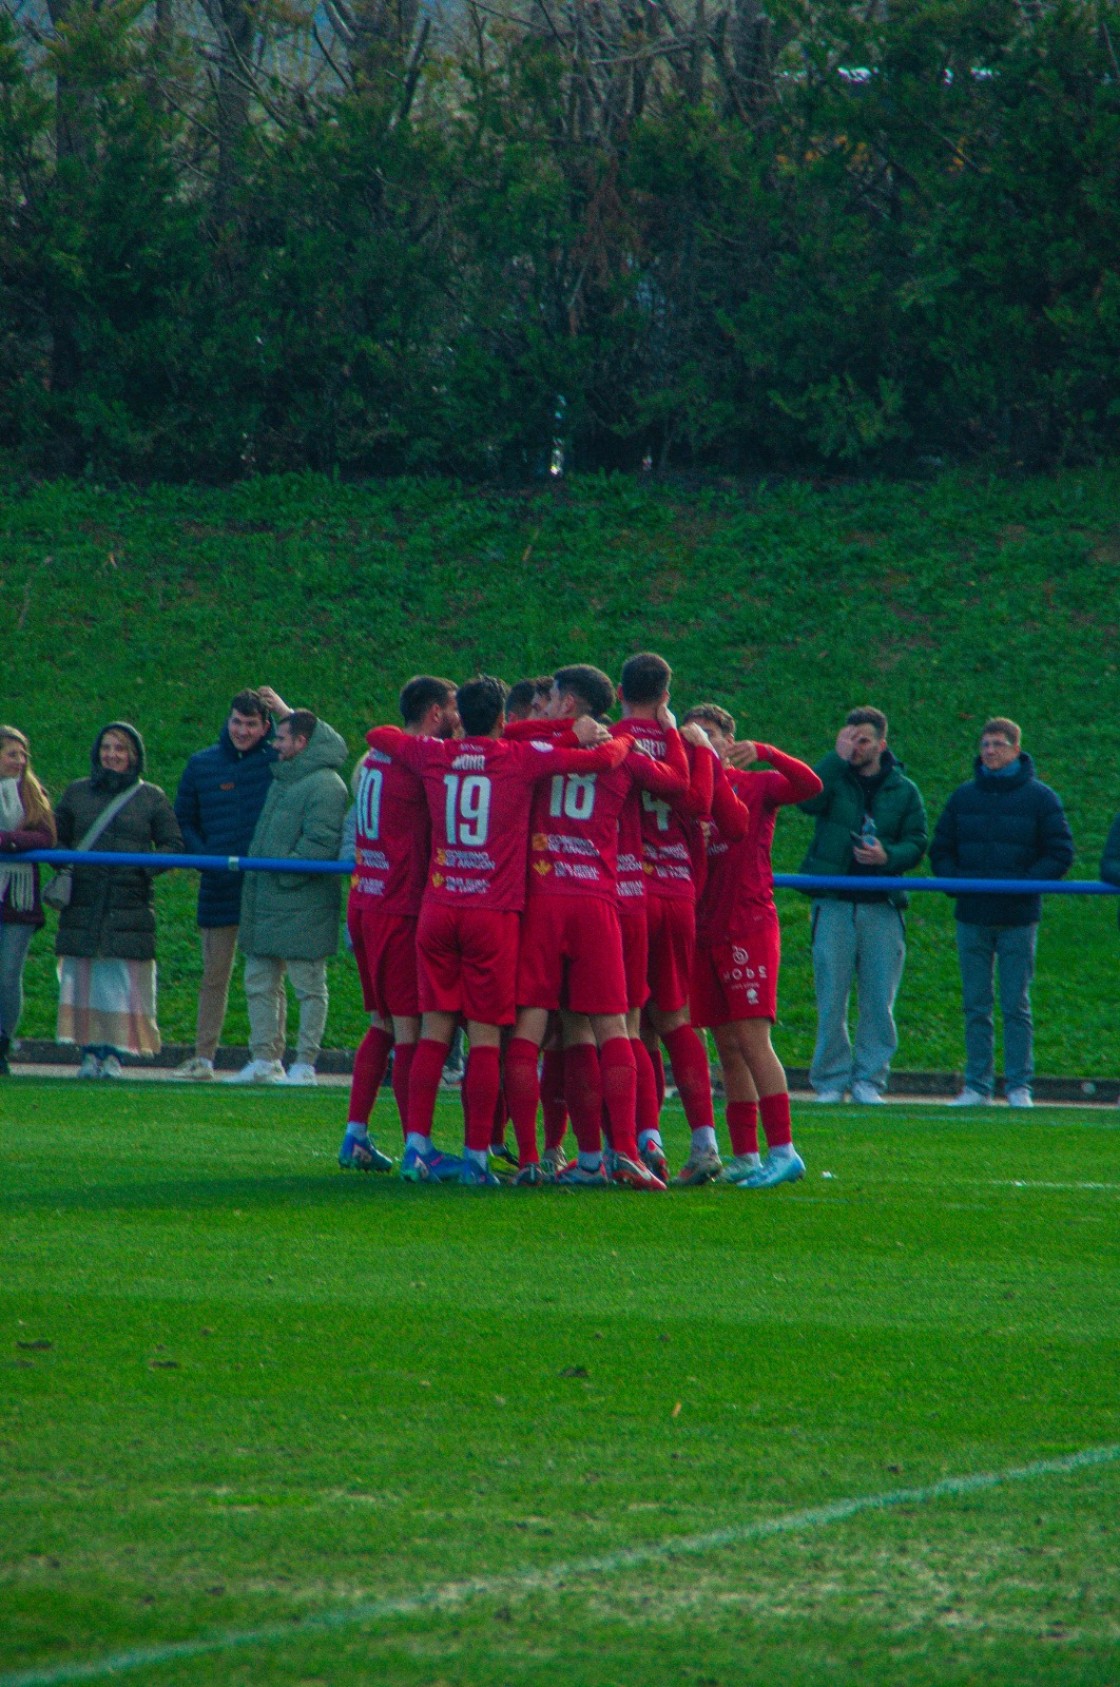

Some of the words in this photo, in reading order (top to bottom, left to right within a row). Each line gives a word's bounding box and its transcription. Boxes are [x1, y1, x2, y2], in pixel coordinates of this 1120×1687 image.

[357, 766, 383, 840] 10
[444, 774, 492, 846] 19
[641, 790, 672, 832] 4
